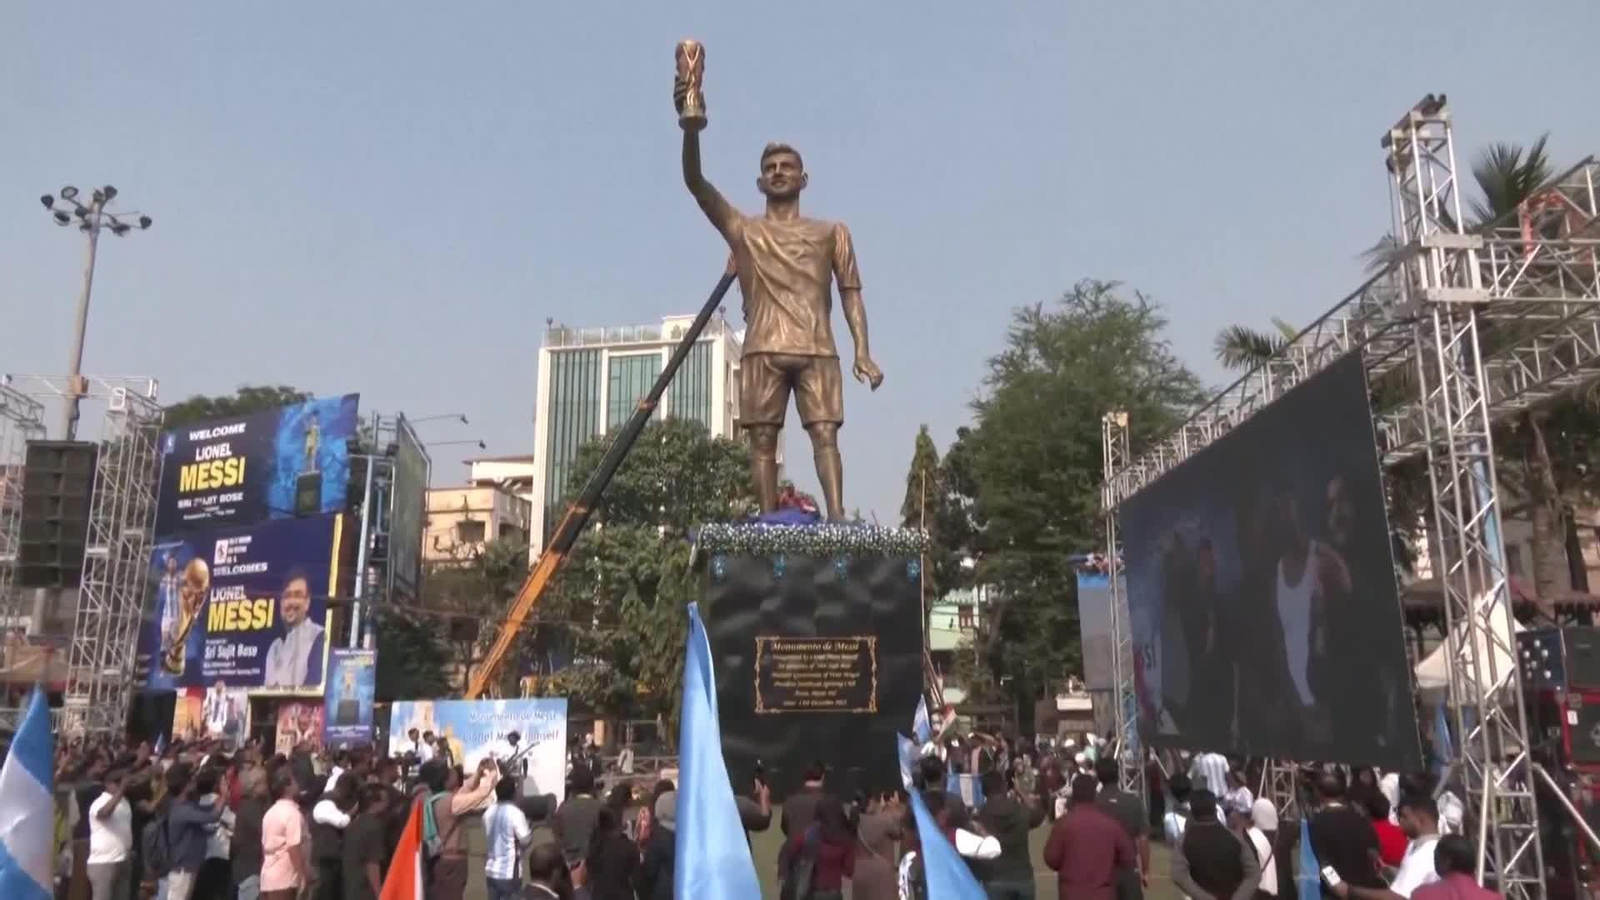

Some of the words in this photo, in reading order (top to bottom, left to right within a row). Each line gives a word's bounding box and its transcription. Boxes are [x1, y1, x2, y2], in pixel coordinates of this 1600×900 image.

[189, 423, 247, 441] WELCOME
[195, 443, 232, 461] LIONEL
[179, 457, 246, 493] MESSI
[219, 492, 244, 503] BOSE
[213, 562, 268, 577] WELCOMES
[210, 586, 247, 603] LIONEL
[207, 599, 275, 633] MESSI
[773, 642, 821, 651] Monumento
[822, 641, 832, 651] de
[834, 641, 860, 651] Messi
